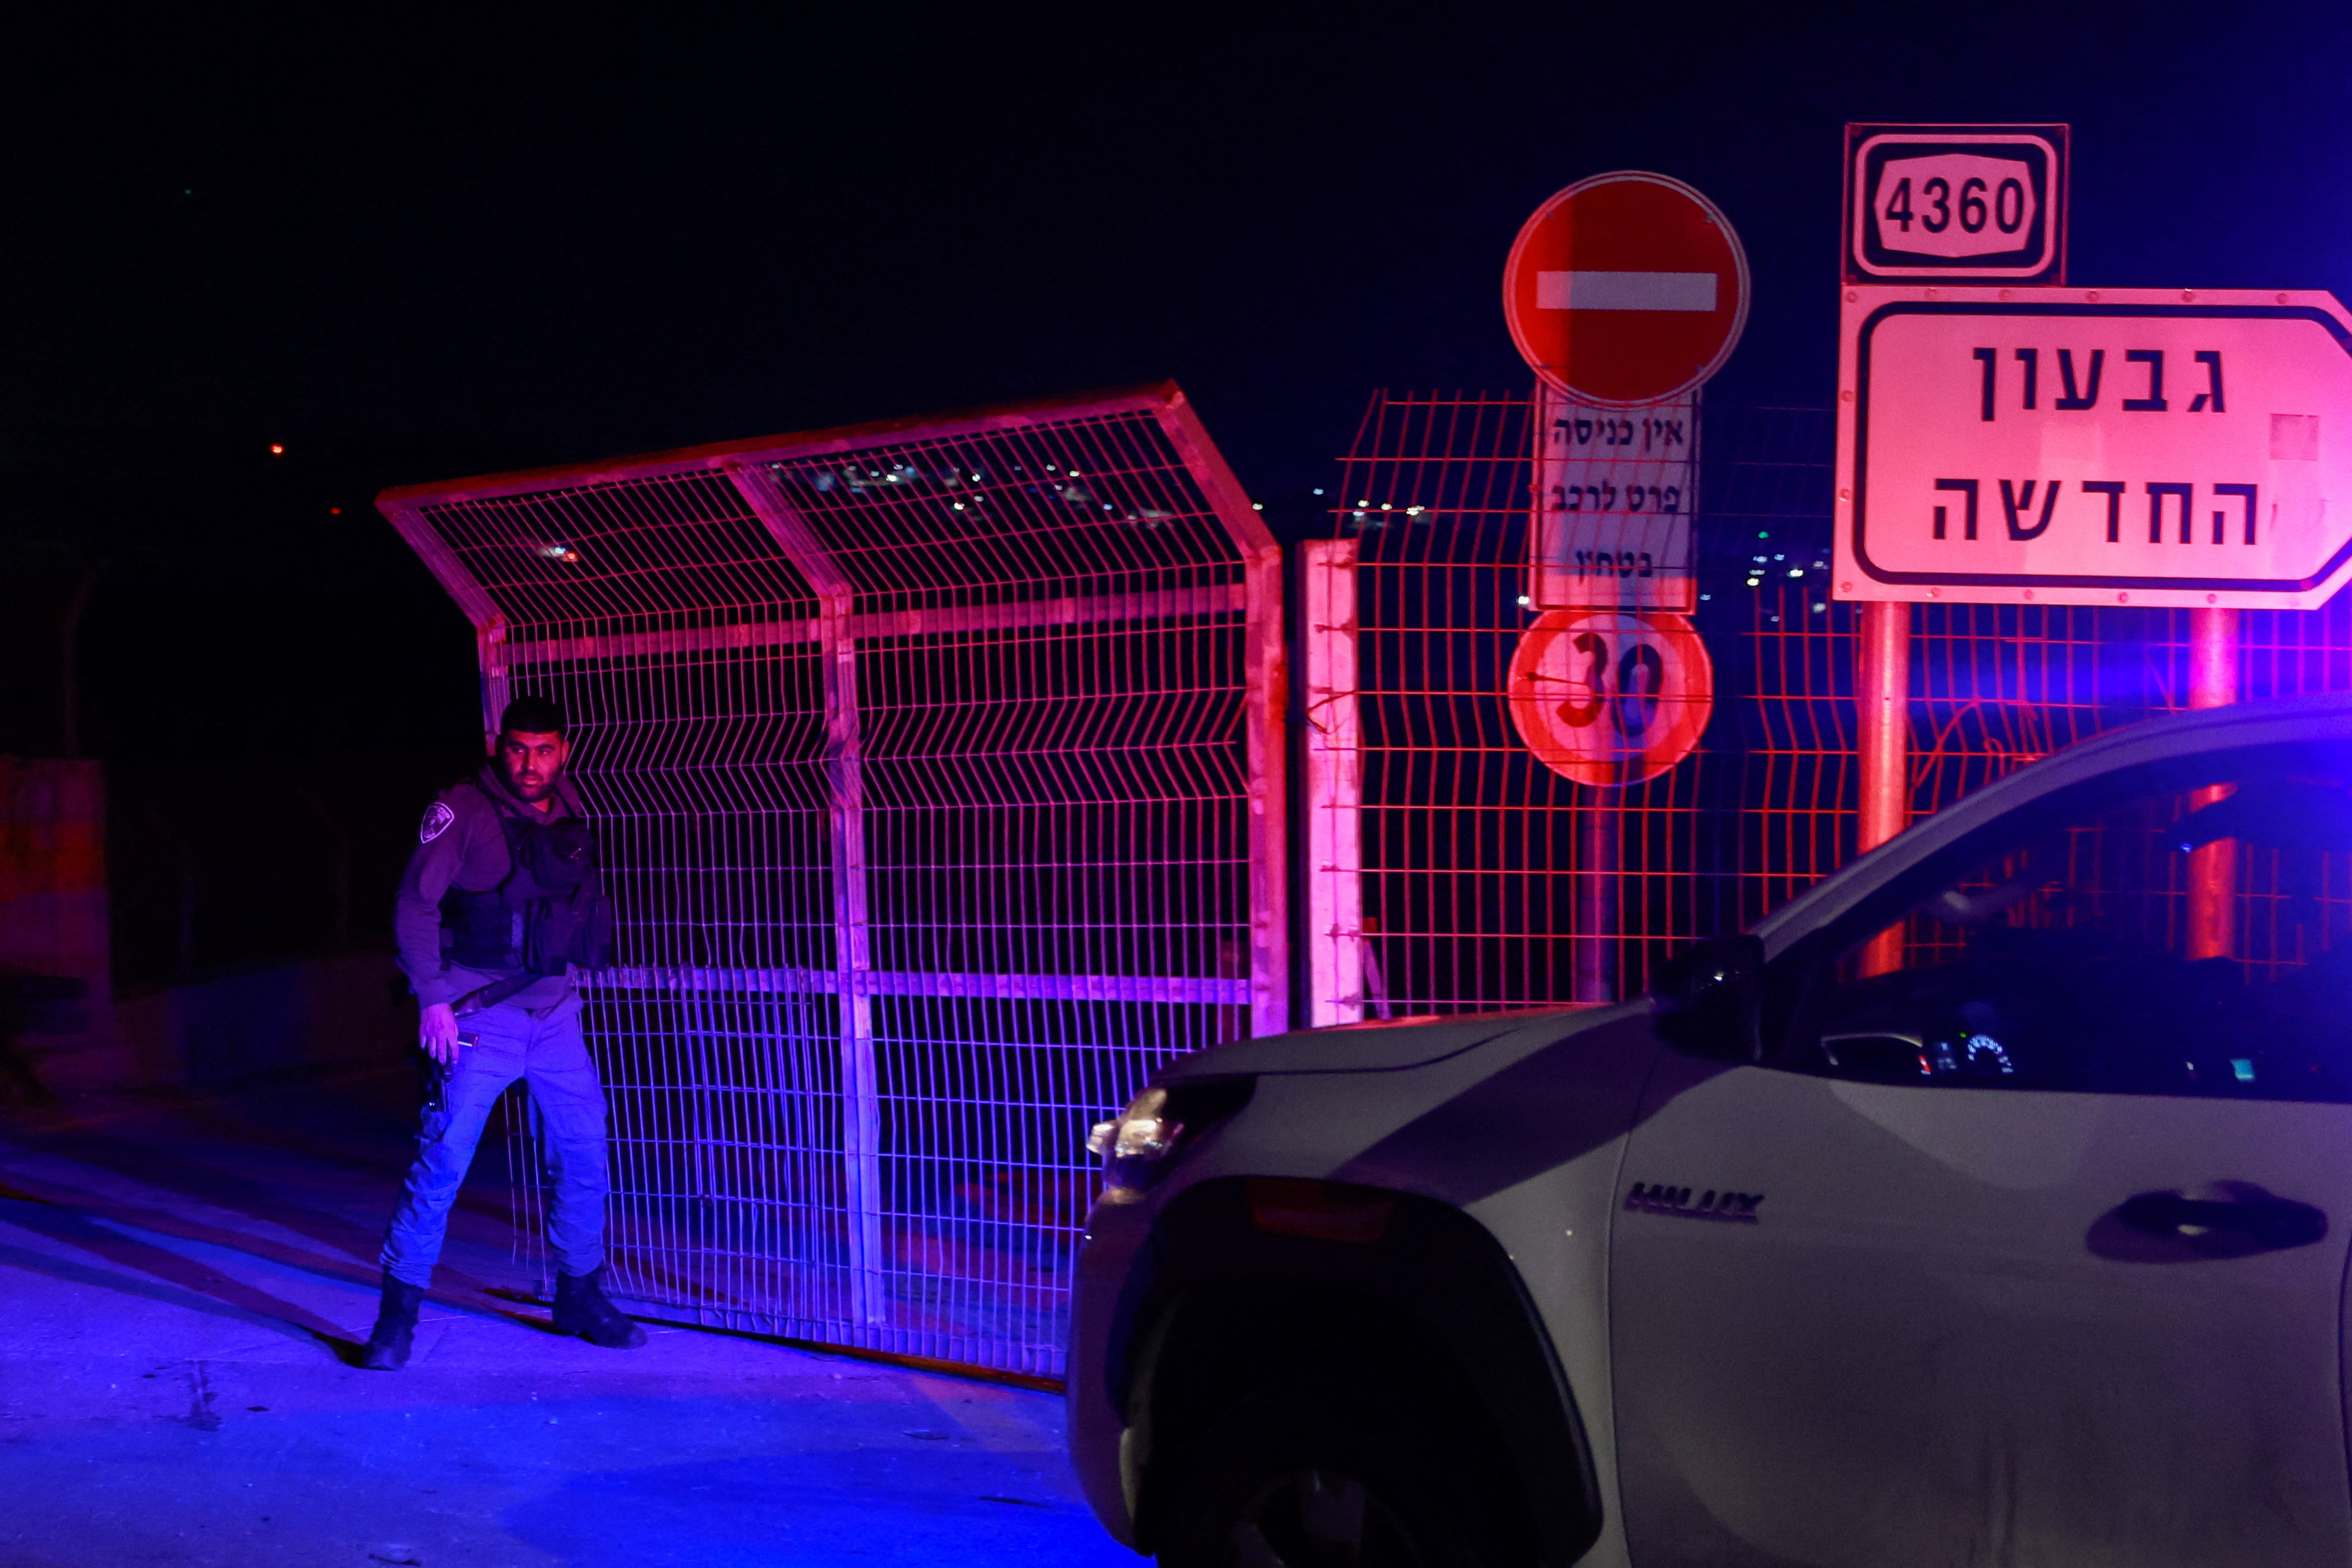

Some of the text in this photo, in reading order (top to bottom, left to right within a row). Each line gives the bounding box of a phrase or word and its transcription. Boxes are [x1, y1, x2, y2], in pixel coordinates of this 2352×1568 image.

[1885, 177, 2025, 235] 4360
[1972, 347, 2227, 423] גבעון
[1554, 419, 1683, 453] אין כניסה
[1552, 479, 1680, 512] פרט לרכב
[1932, 478, 2258, 546] החדשה
[1556, 633, 1663, 738] 30
[1623, 1182, 1764, 1223] HILUX
